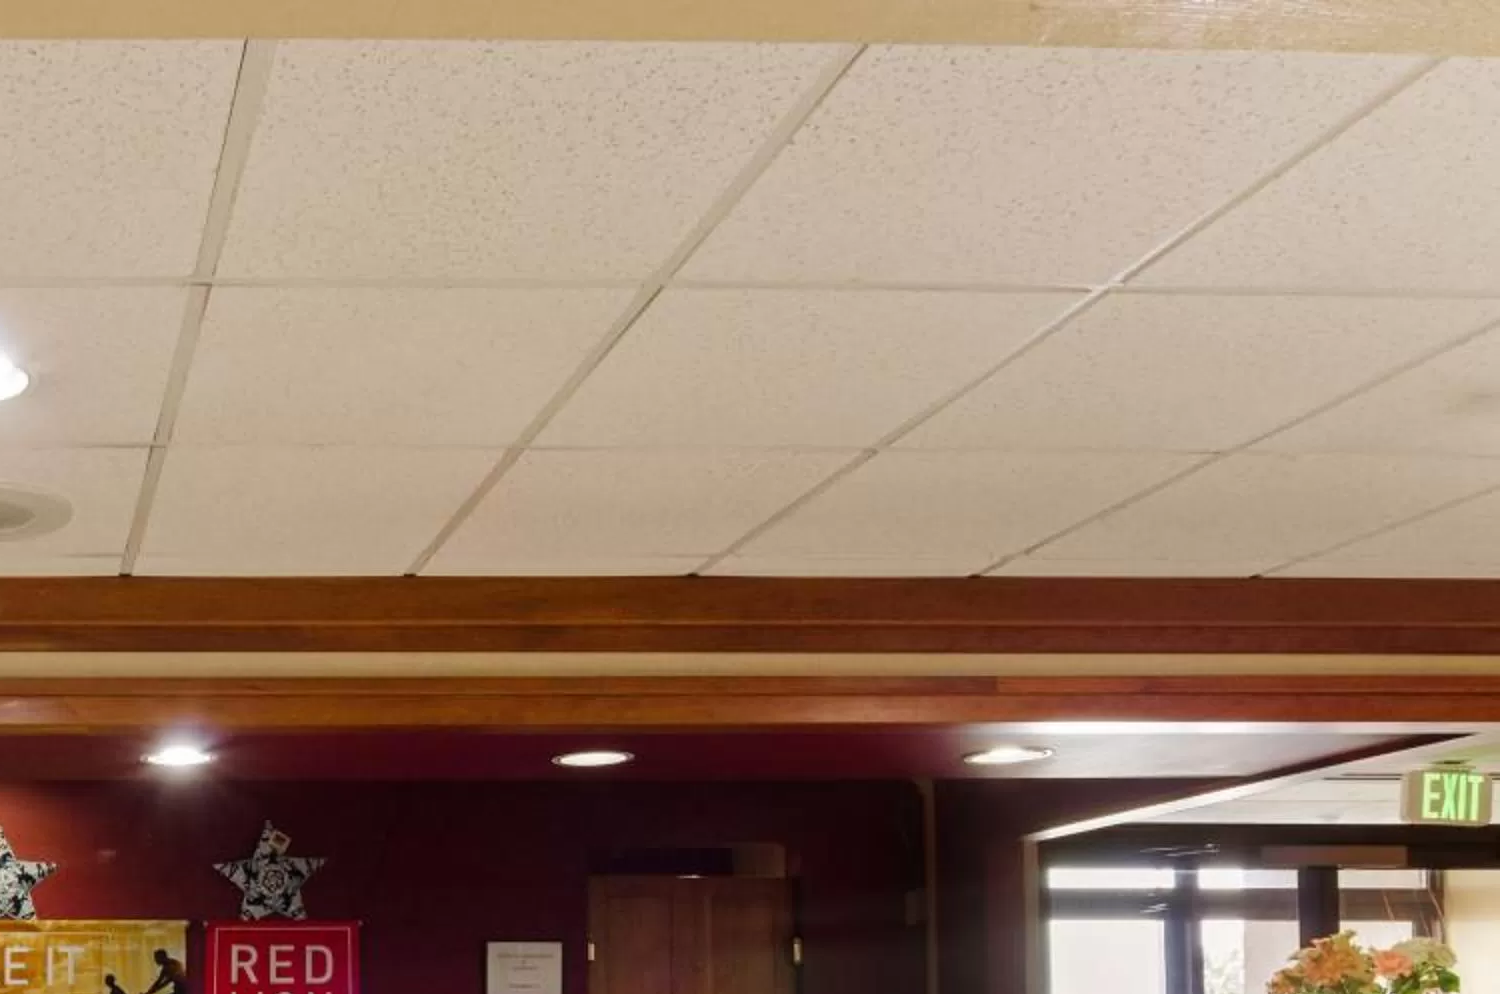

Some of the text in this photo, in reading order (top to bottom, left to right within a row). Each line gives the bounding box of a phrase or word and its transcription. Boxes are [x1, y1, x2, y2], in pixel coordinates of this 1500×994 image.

[1422, 772, 1484, 820] EXIT
[46, 945, 84, 986] IT
[230, 944, 334, 985] RED
